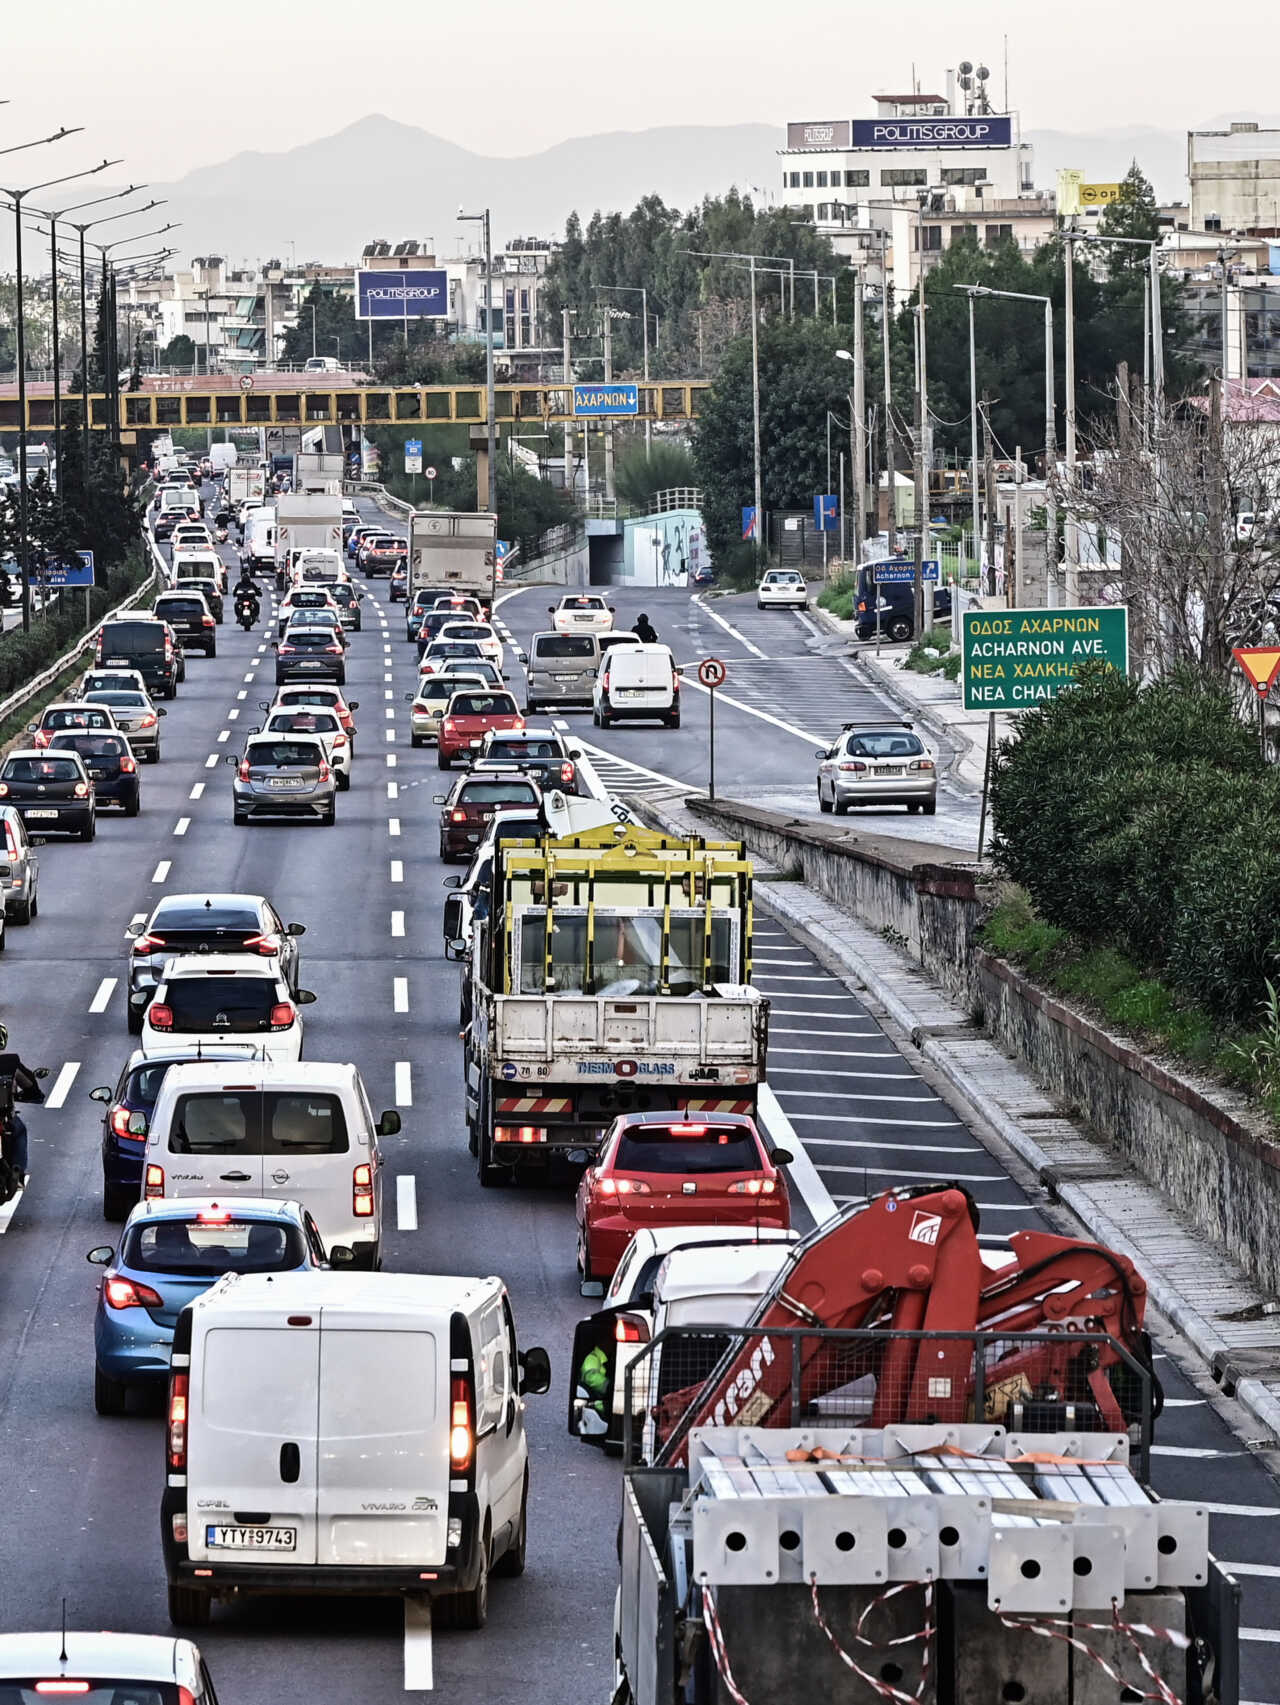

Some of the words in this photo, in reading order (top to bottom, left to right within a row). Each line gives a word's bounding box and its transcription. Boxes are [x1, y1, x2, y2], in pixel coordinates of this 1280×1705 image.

[970, 619, 1013, 635] ΟΔΟΣ
[1020, 617, 1100, 634] ΑΧΑΡΝΩΝ
[971, 640, 1064, 657] ACHARNON
[1072, 639, 1108, 654] AVE.
[971, 664, 1005, 679] ΝΕΑ
[971, 686, 1005, 701] NEA
[537, 1065, 548, 1076] 80
[197, 1499, 231, 1508] OPEL
[362, 1503, 406, 1511] VIVARO
